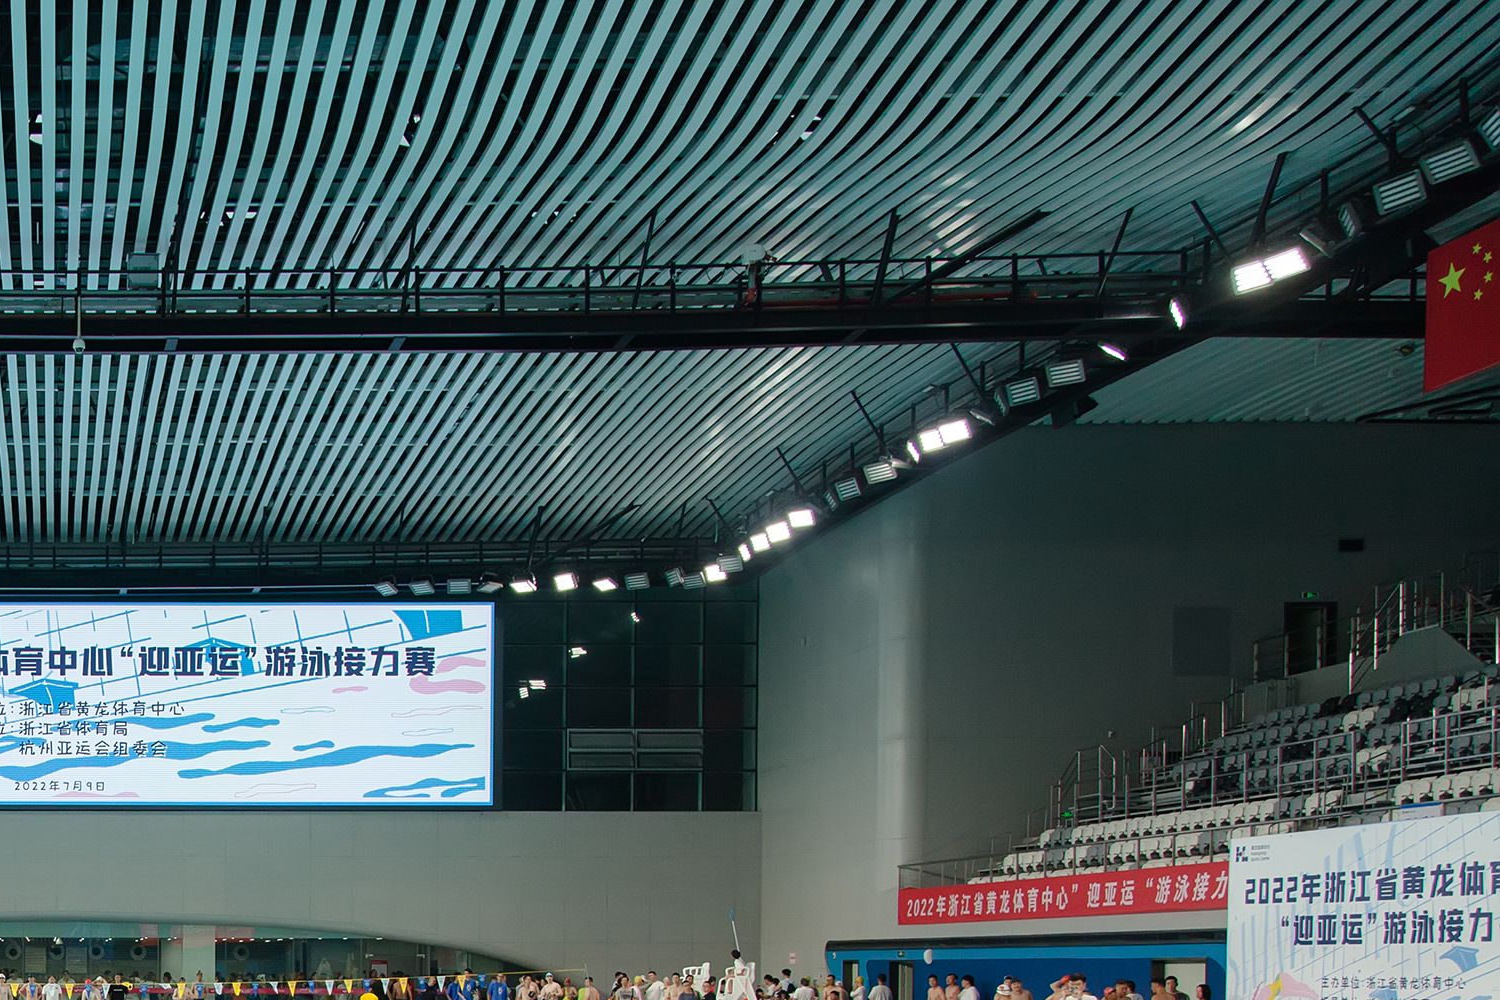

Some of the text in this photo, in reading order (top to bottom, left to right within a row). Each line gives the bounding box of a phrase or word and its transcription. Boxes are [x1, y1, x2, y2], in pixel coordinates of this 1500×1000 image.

[19, 740, 168, 757] 杭州亚运会组委会
[14, 781, 105, 792] 2022年7月9日
